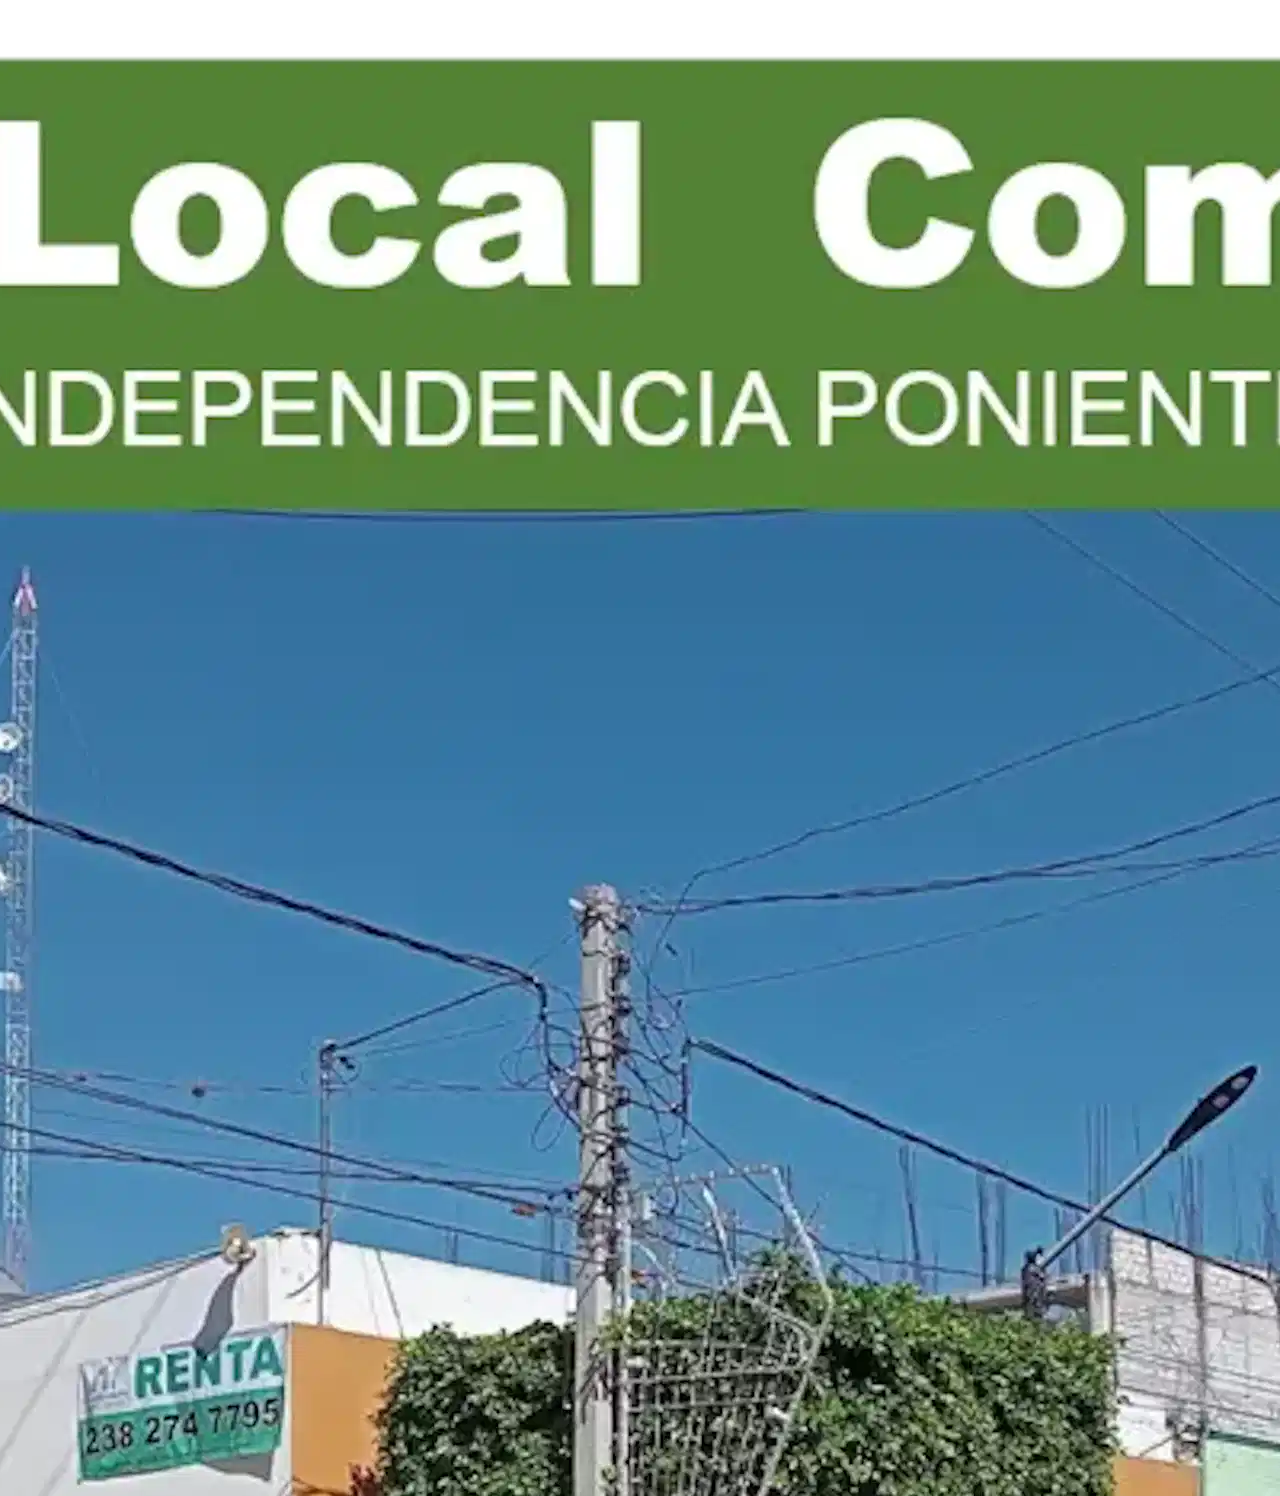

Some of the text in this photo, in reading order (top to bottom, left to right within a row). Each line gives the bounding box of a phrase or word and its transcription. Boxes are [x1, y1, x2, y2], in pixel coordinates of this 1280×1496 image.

[135, 1336, 282, 1398] RENTA
[86, 1399, 280, 1454] 238 274 7795
